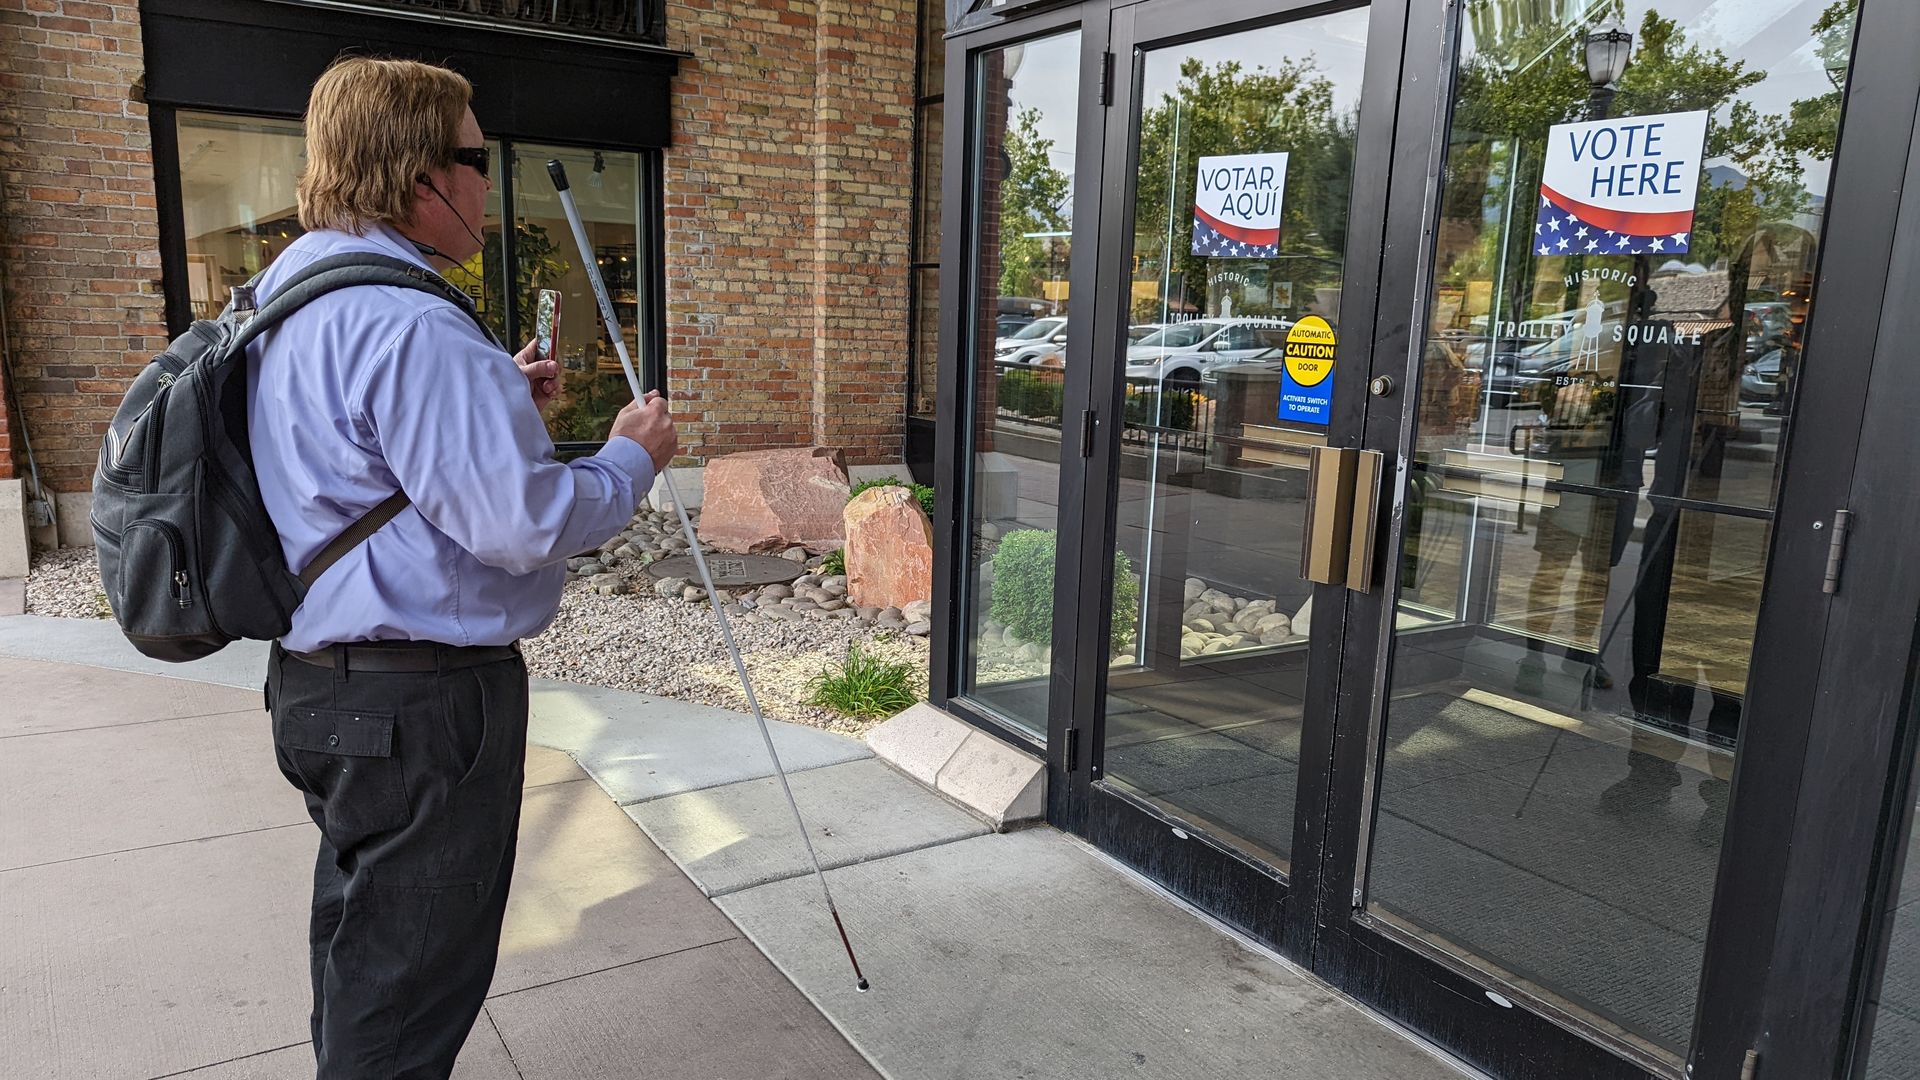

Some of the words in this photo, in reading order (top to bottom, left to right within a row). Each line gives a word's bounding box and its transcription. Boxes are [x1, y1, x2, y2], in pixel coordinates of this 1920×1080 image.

[1569, 123, 1664, 162] VOTE
[1201, 166, 1274, 191] VOTAR
[1590, 160, 1684, 198] HERE
[1220, 186, 1280, 220] AQUÍ
[1208, 271, 1250, 287] HISTORIC
[1564, 268, 1637, 288] HISTORIC
[1169, 312, 1215, 326] TROLLEY
[1237, 314, 1287, 330] SQUARE
[1292, 329, 1331, 339] AUTOMATIC
[1497, 320, 1573, 340] TROLLEY
[1612, 324, 1701, 346] SQUARE
[1286, 343, 1334, 358] CAUTION
[1298, 362, 1318, 372] DOOR
[1282, 394, 1306, 403] ACTIVATE
[1307, 396, 1328, 406] SWITCH
[1288, 403, 1296, 411] TO
[1297, 404, 1320, 414] OPERATE
